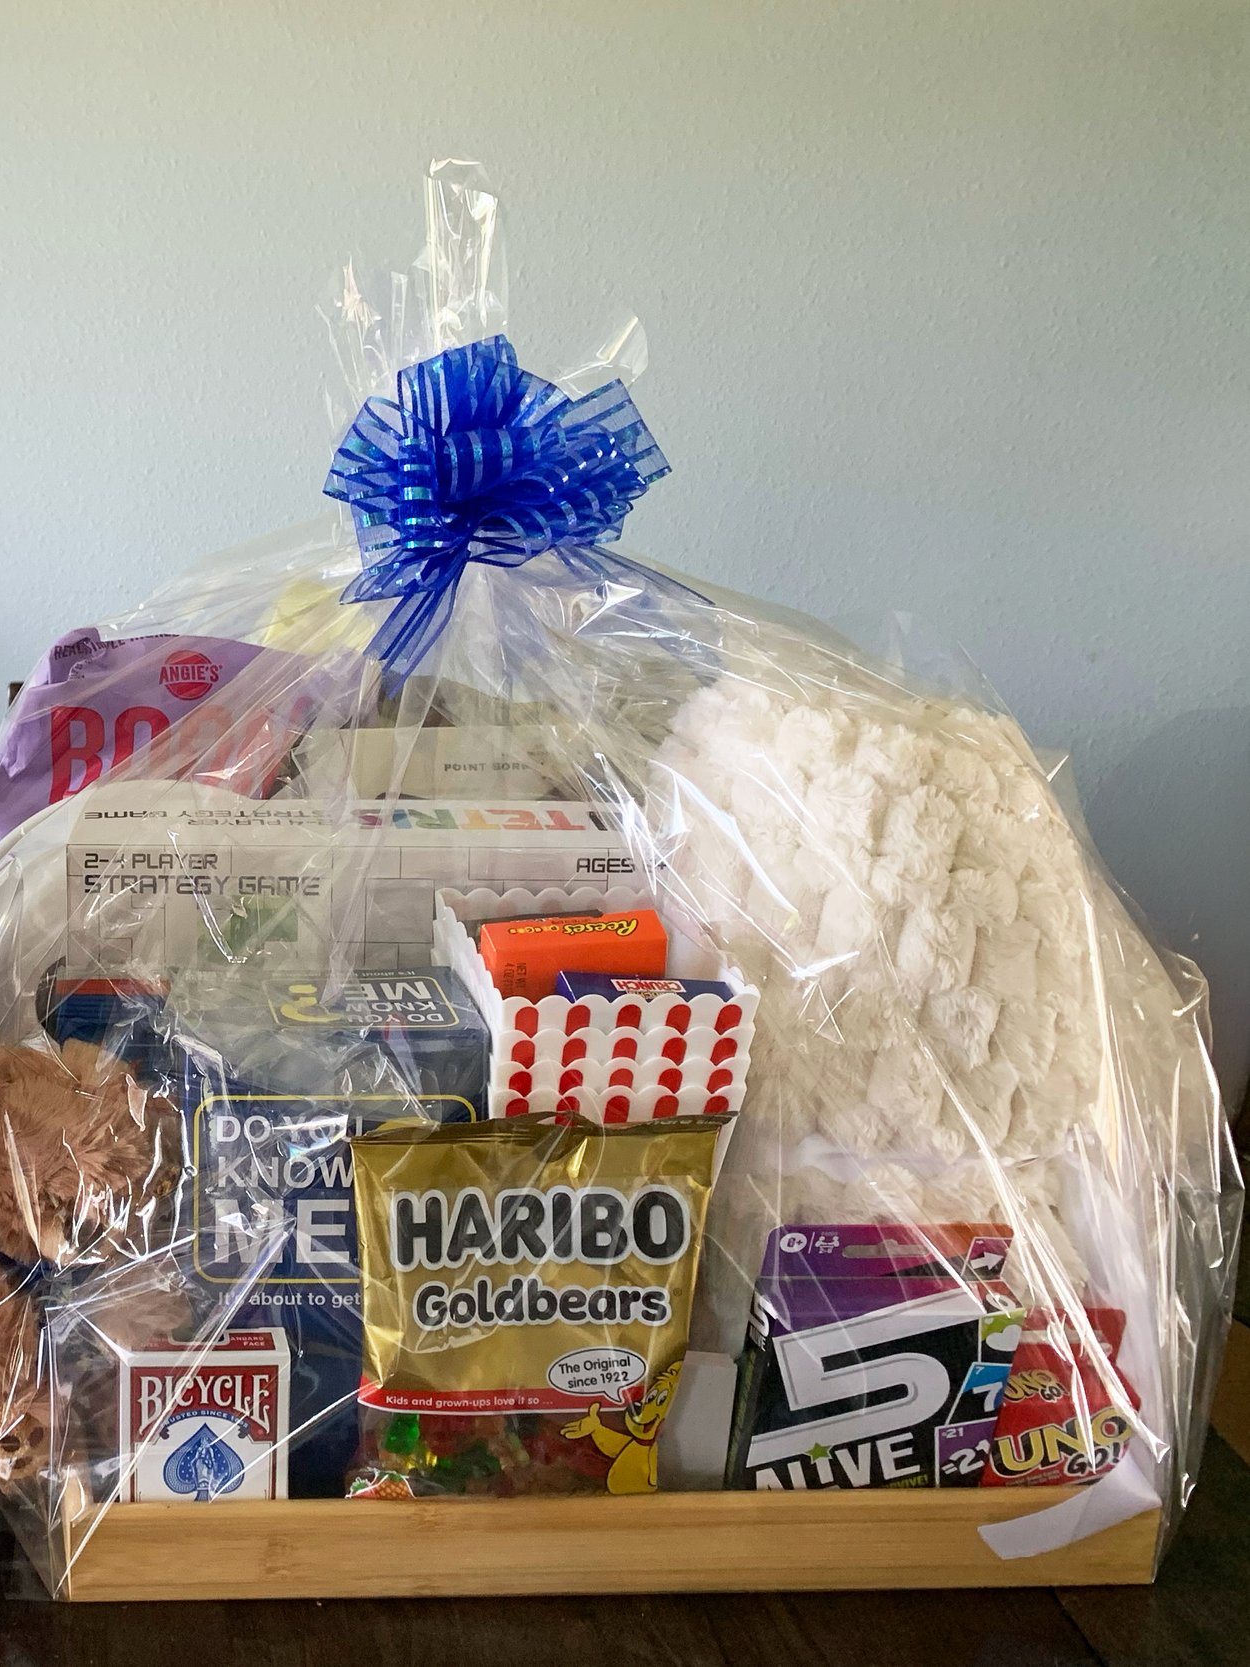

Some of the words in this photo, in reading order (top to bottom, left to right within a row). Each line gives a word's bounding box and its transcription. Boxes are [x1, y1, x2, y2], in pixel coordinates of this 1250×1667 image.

[159, 665, 220, 685] ANGIE'S
[443, 763, 486, 772] POINT
[351, 808, 586, 831] TETRIS
[132, 853, 218, 870] PLAYER
[576, 858, 636, 873] AGES
[84, 874, 230, 896] STRATEGY
[238, 875, 321, 896] GAME
[563, 918, 639, 936] Reese's
[343, 980, 433, 1000] ME
[619, 980, 683, 992] CRUNCH
[345, 1001, 438, 1013] KNOW
[347, 1013, 401, 1024] YOU
[406, 1012, 445, 1024] DO
[216, 1115, 272, 1143] DO
[217, 1156, 355, 1189] KNOW
[214, 1199, 350, 1264] ME
[393, 1187, 689, 1269] HARIBO
[250, 1291, 302, 1307] about
[308, 1292, 326, 1307] to
[331, 1291, 362, 1309] get
[414, 1276, 669, 1328] Goldbears
[559, 1363, 581, 1376] The
[583, 1355, 631, 1374] Original
[567, 1376, 598, 1389] since
[599, 1371, 630, 1385] 1922
[746, 1287, 988, 1469] 5
[1003, 1369, 1059, 1400] UNO
[137, 1373, 271, 1436] BICYCLE
[385, 1395, 408, 1406] Kids
[411, 1396, 431, 1406] and
[435, 1396, 492, 1409] grown-ups
[493, 1395, 516, 1406] love
[517, 1396, 526, 1406] it
[527, 1397, 540, 1406] so
[972, 1381, 1004, 1413] 7
[200, 1410, 228, 1419] SINCE
[993, 1408, 1133, 1475] UNO
[1065, 1442, 1122, 1476] GO!
